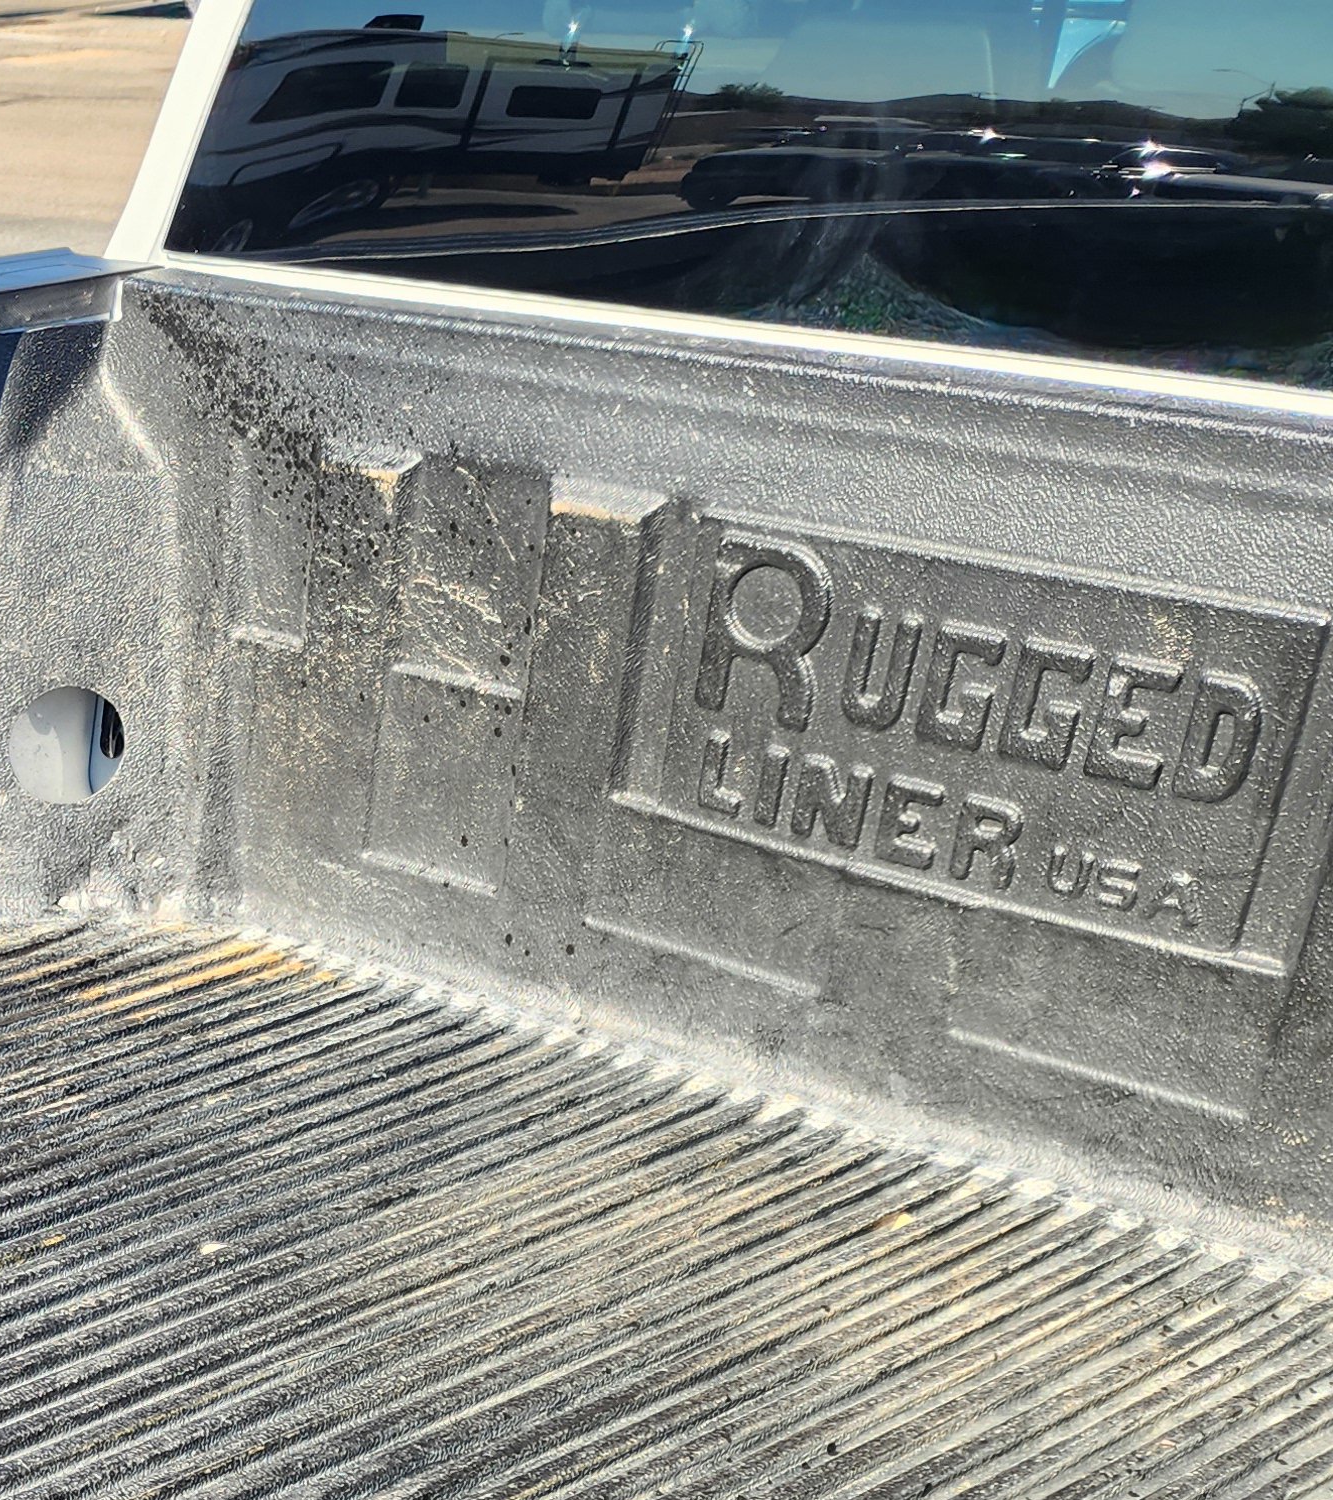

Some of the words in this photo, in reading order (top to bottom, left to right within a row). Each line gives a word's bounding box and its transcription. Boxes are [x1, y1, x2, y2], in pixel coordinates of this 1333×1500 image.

[694, 529, 1264, 802] RUGGED
[697, 729, 1025, 891] LINER
[1046, 845, 1203, 928] USA
